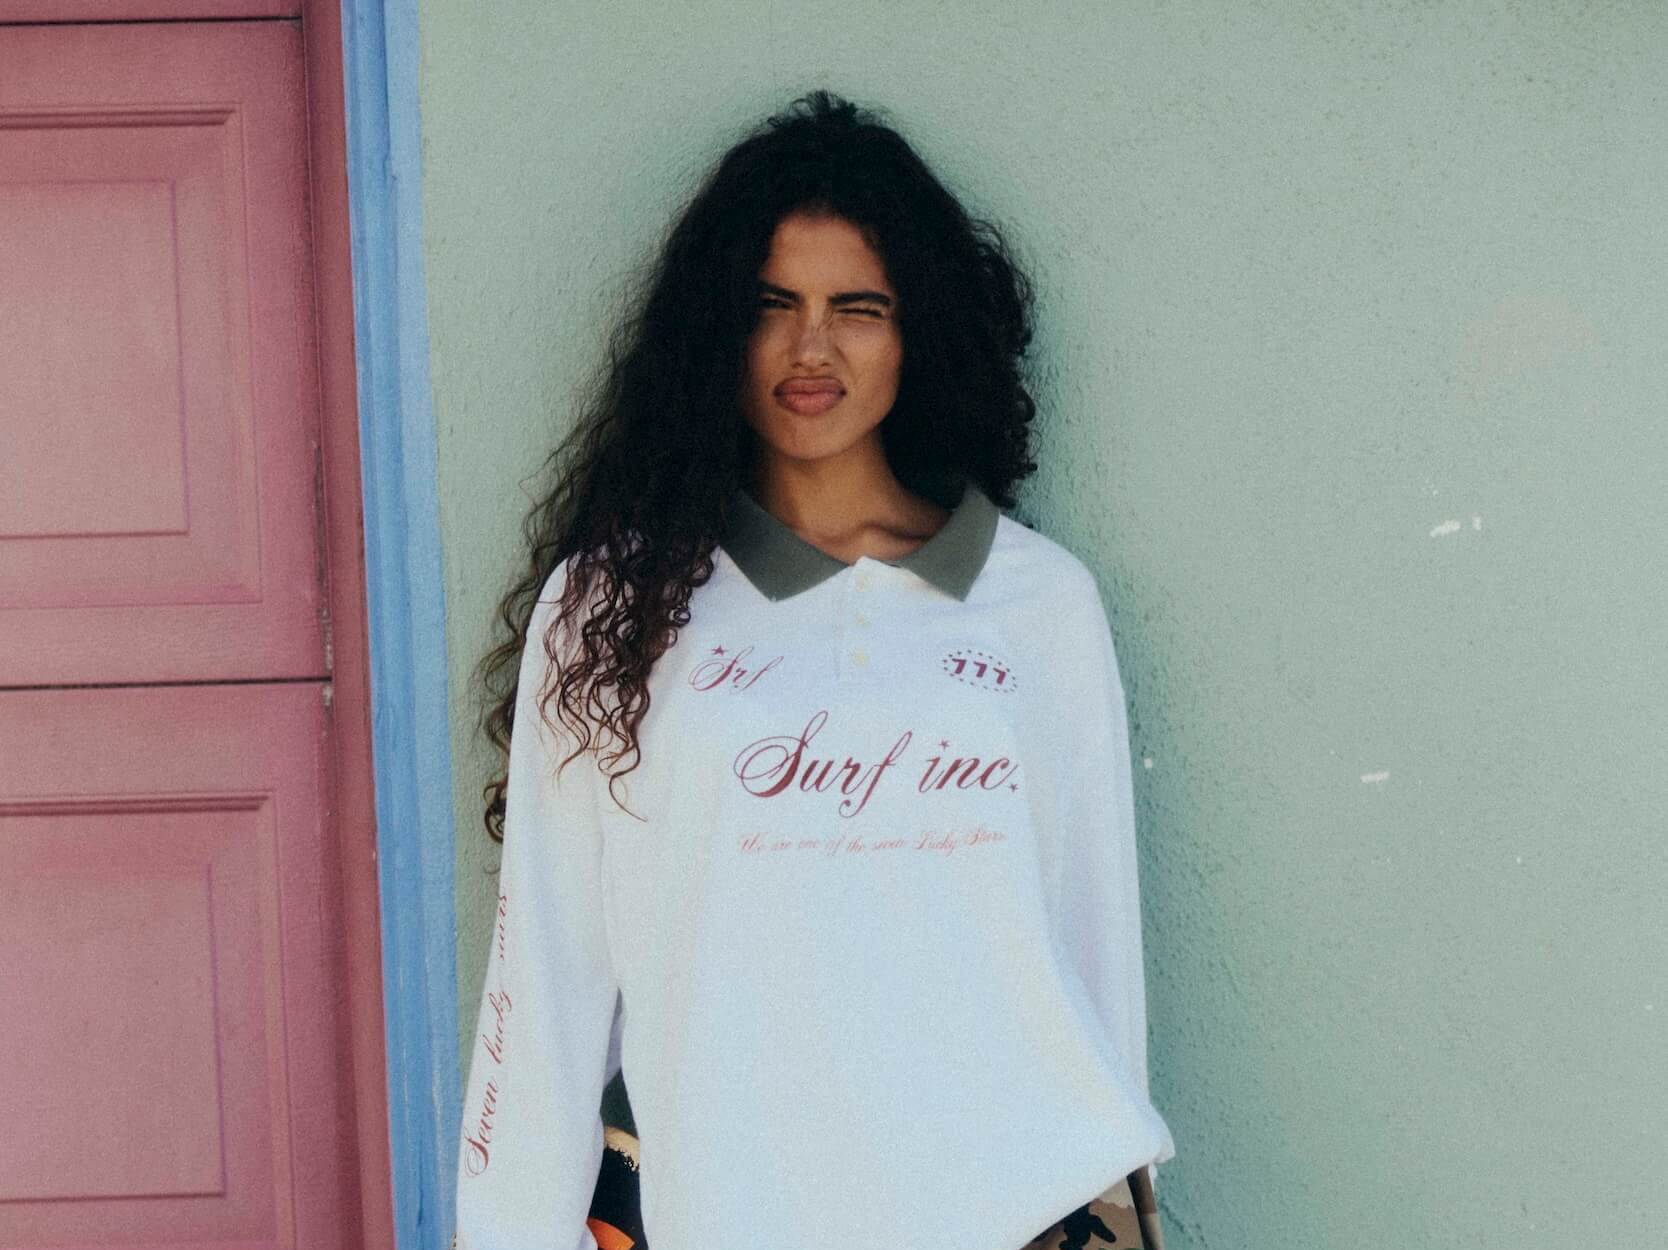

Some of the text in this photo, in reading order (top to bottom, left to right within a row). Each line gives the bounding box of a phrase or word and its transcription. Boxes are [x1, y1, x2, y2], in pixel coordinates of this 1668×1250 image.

[733, 710, 912, 818] Surf
[464, 1076, 500, 1177] Seven
[482, 990, 513, 1065] lucky
